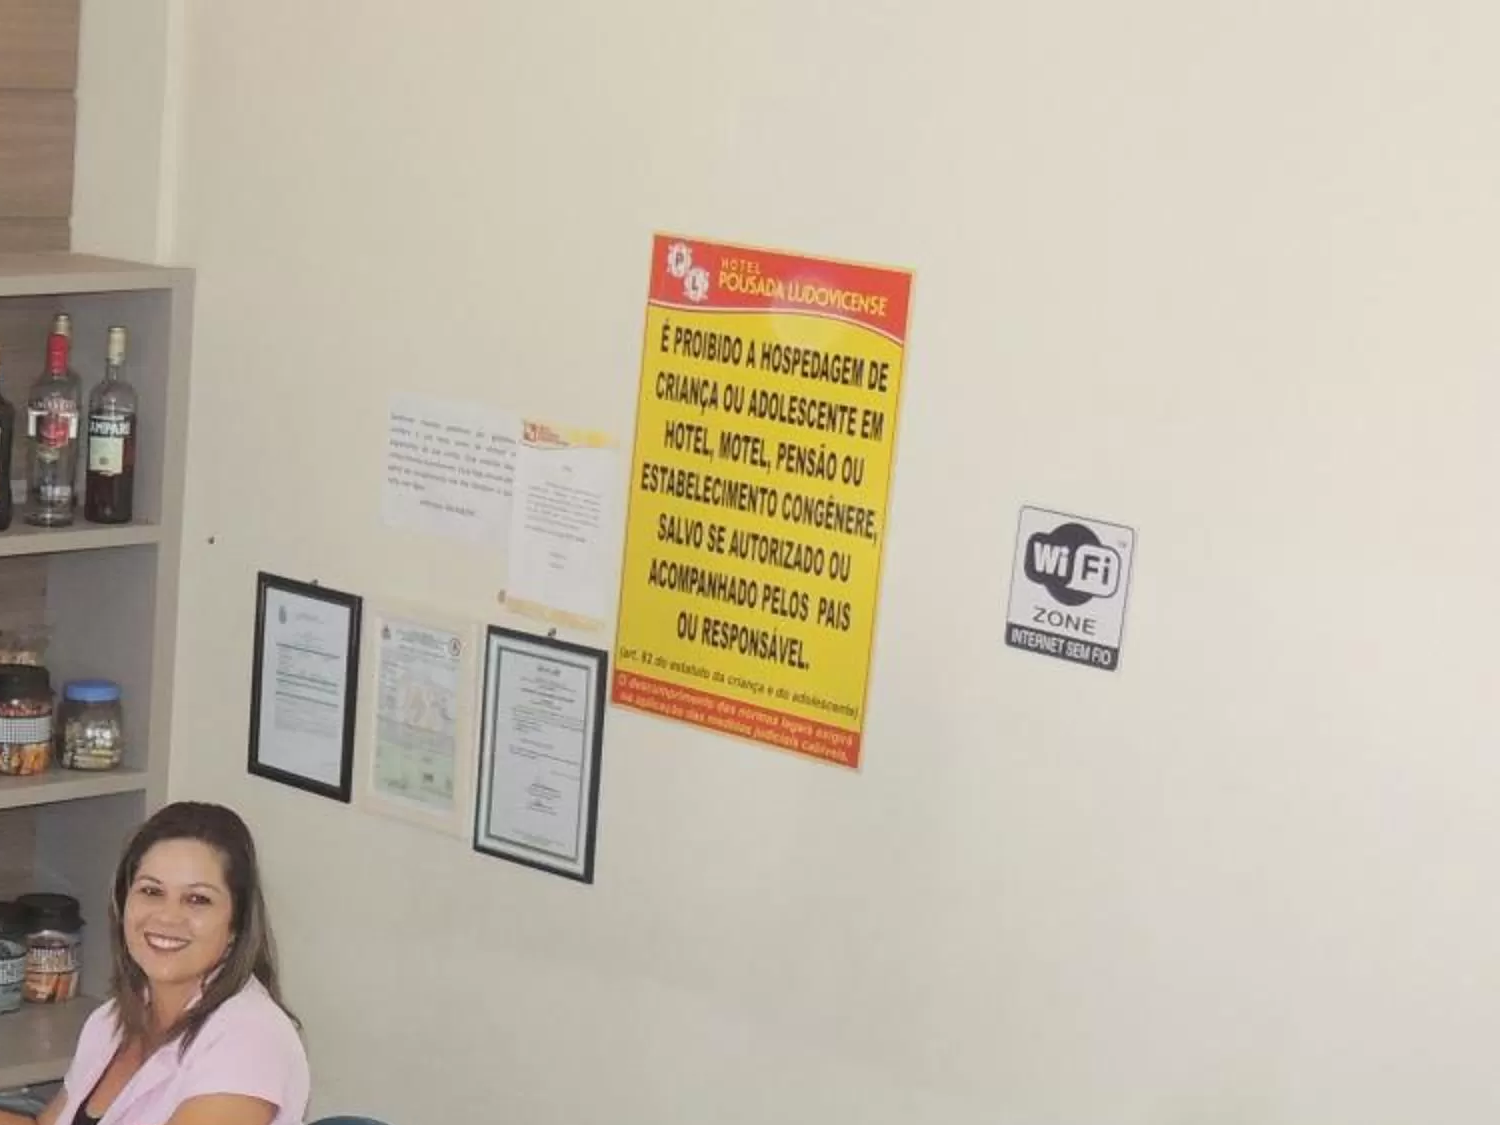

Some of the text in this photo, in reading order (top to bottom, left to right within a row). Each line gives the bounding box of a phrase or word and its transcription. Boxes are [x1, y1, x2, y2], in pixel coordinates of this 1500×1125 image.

[718, 270, 888, 317] POUSADA LUDOVICENSE
[719, 255, 761, 275] HOTEL
[660, 318, 890, 393] É PROIBIDO A HOSPEDAGEM DE
[655, 371, 885, 442] CRIANÇA OU ADOLESCENTE EM
[664, 420, 866, 487] HOTEL, MOTEL, PENSÃO OU
[641, 463, 778, 518] ESTABELECIMENTO
[781, 495, 878, 548] CONGÊNERE,
[657, 513, 852, 582] SALVO SE AUTORIZADO OU
[648, 558, 851, 631] ACOMPANHADO PELOS PAIS
[1032, 605, 1098, 636] ZONE
[676, 611, 810, 671] OU RESPONSÁVEL.
[1011, 628, 1112, 665] INTERNET SEM FIO
[669, 660, 710, 679] estatuto
[727, 674, 765, 694] criança
